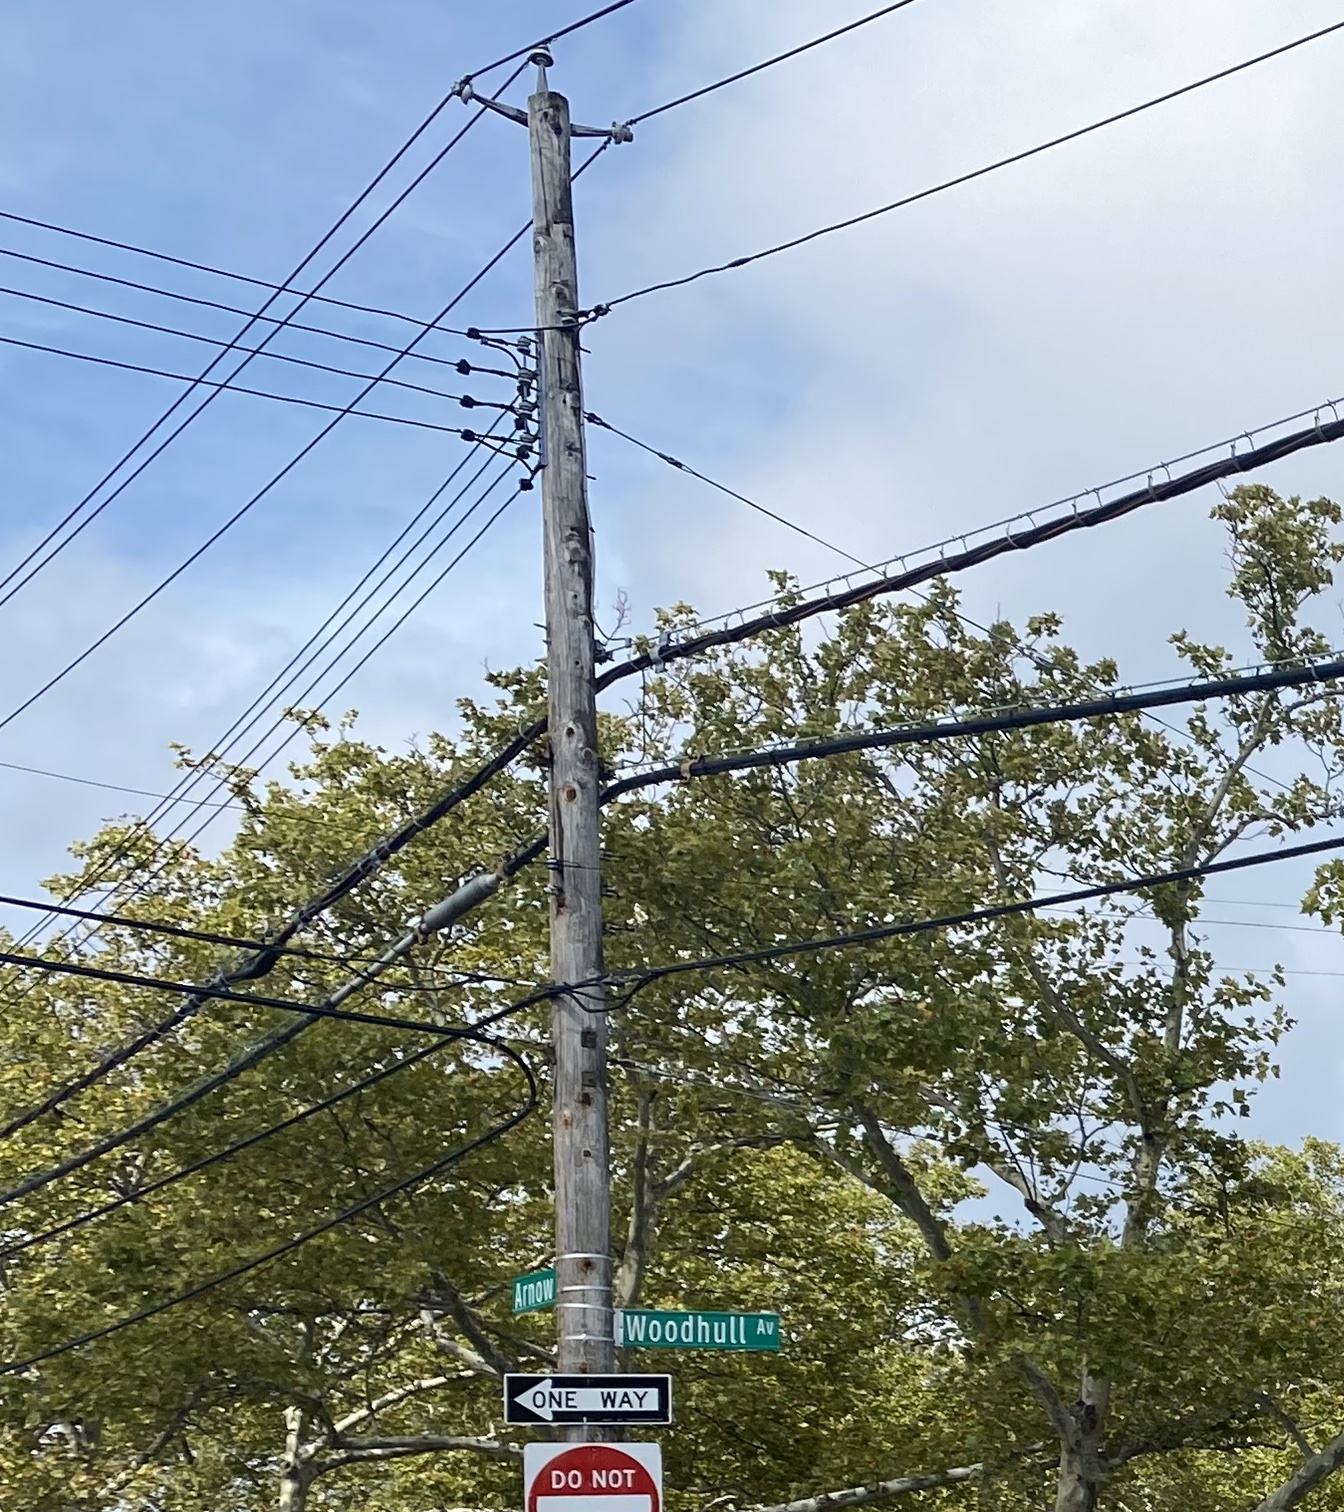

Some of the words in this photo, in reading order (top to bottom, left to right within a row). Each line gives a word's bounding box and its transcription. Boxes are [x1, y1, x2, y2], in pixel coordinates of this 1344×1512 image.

[514, 1277, 554, 1308] Arnow
[626, 1314, 747, 1345] Woodhull
[756, 1318, 775, 1336] Av
[531, 1391, 578, 1410] ONE
[600, 1390, 650, 1410] WAY
[551, 1469, 583, 1490] DO
[591, 1468, 636, 1489] NOT
